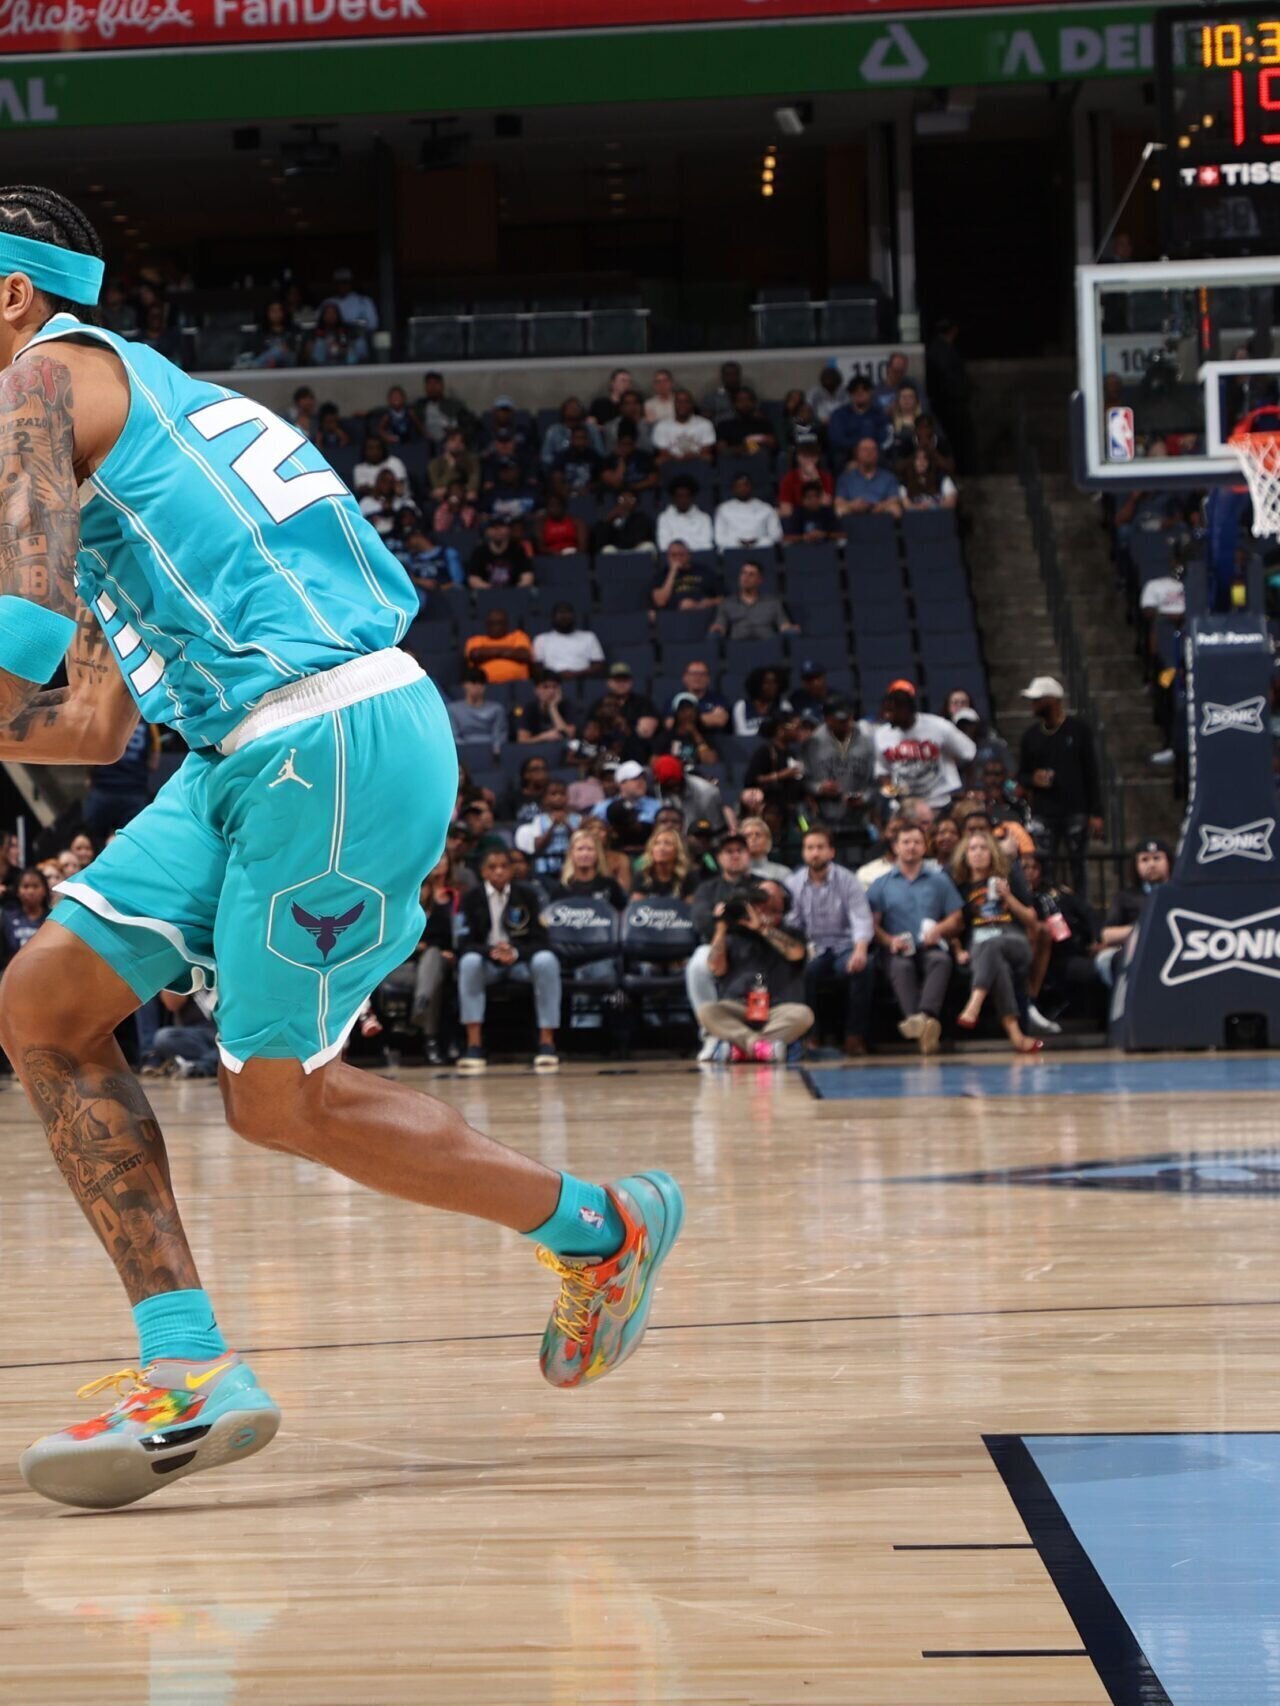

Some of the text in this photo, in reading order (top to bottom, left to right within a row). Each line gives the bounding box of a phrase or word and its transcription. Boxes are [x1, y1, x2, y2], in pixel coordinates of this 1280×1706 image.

[213, 0, 427, 27] FanDeck
[1209, 708, 1259, 725] SONIC
[1208, 832, 1265, 851] SONIC
